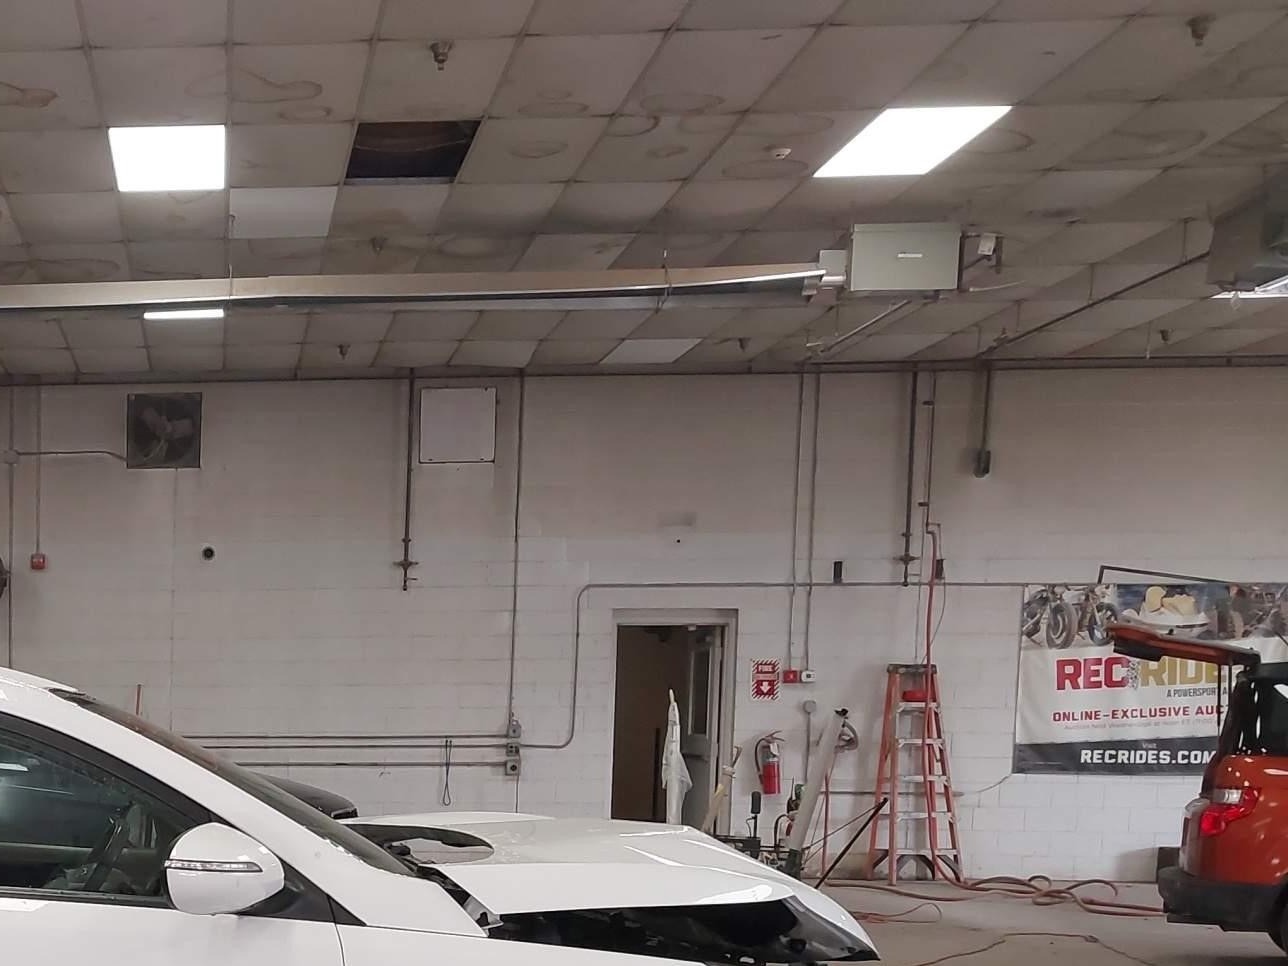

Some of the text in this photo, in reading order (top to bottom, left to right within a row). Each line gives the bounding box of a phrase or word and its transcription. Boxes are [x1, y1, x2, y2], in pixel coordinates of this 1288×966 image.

[1056, 657, 1129, 690] REC
[1174, 688, 1220, 698] POWERSPOR
[1053, 705, 1190, 722] ONLINE-EXCLUSIVE
[1080, 750, 1216, 765] RECRIDES.COM
